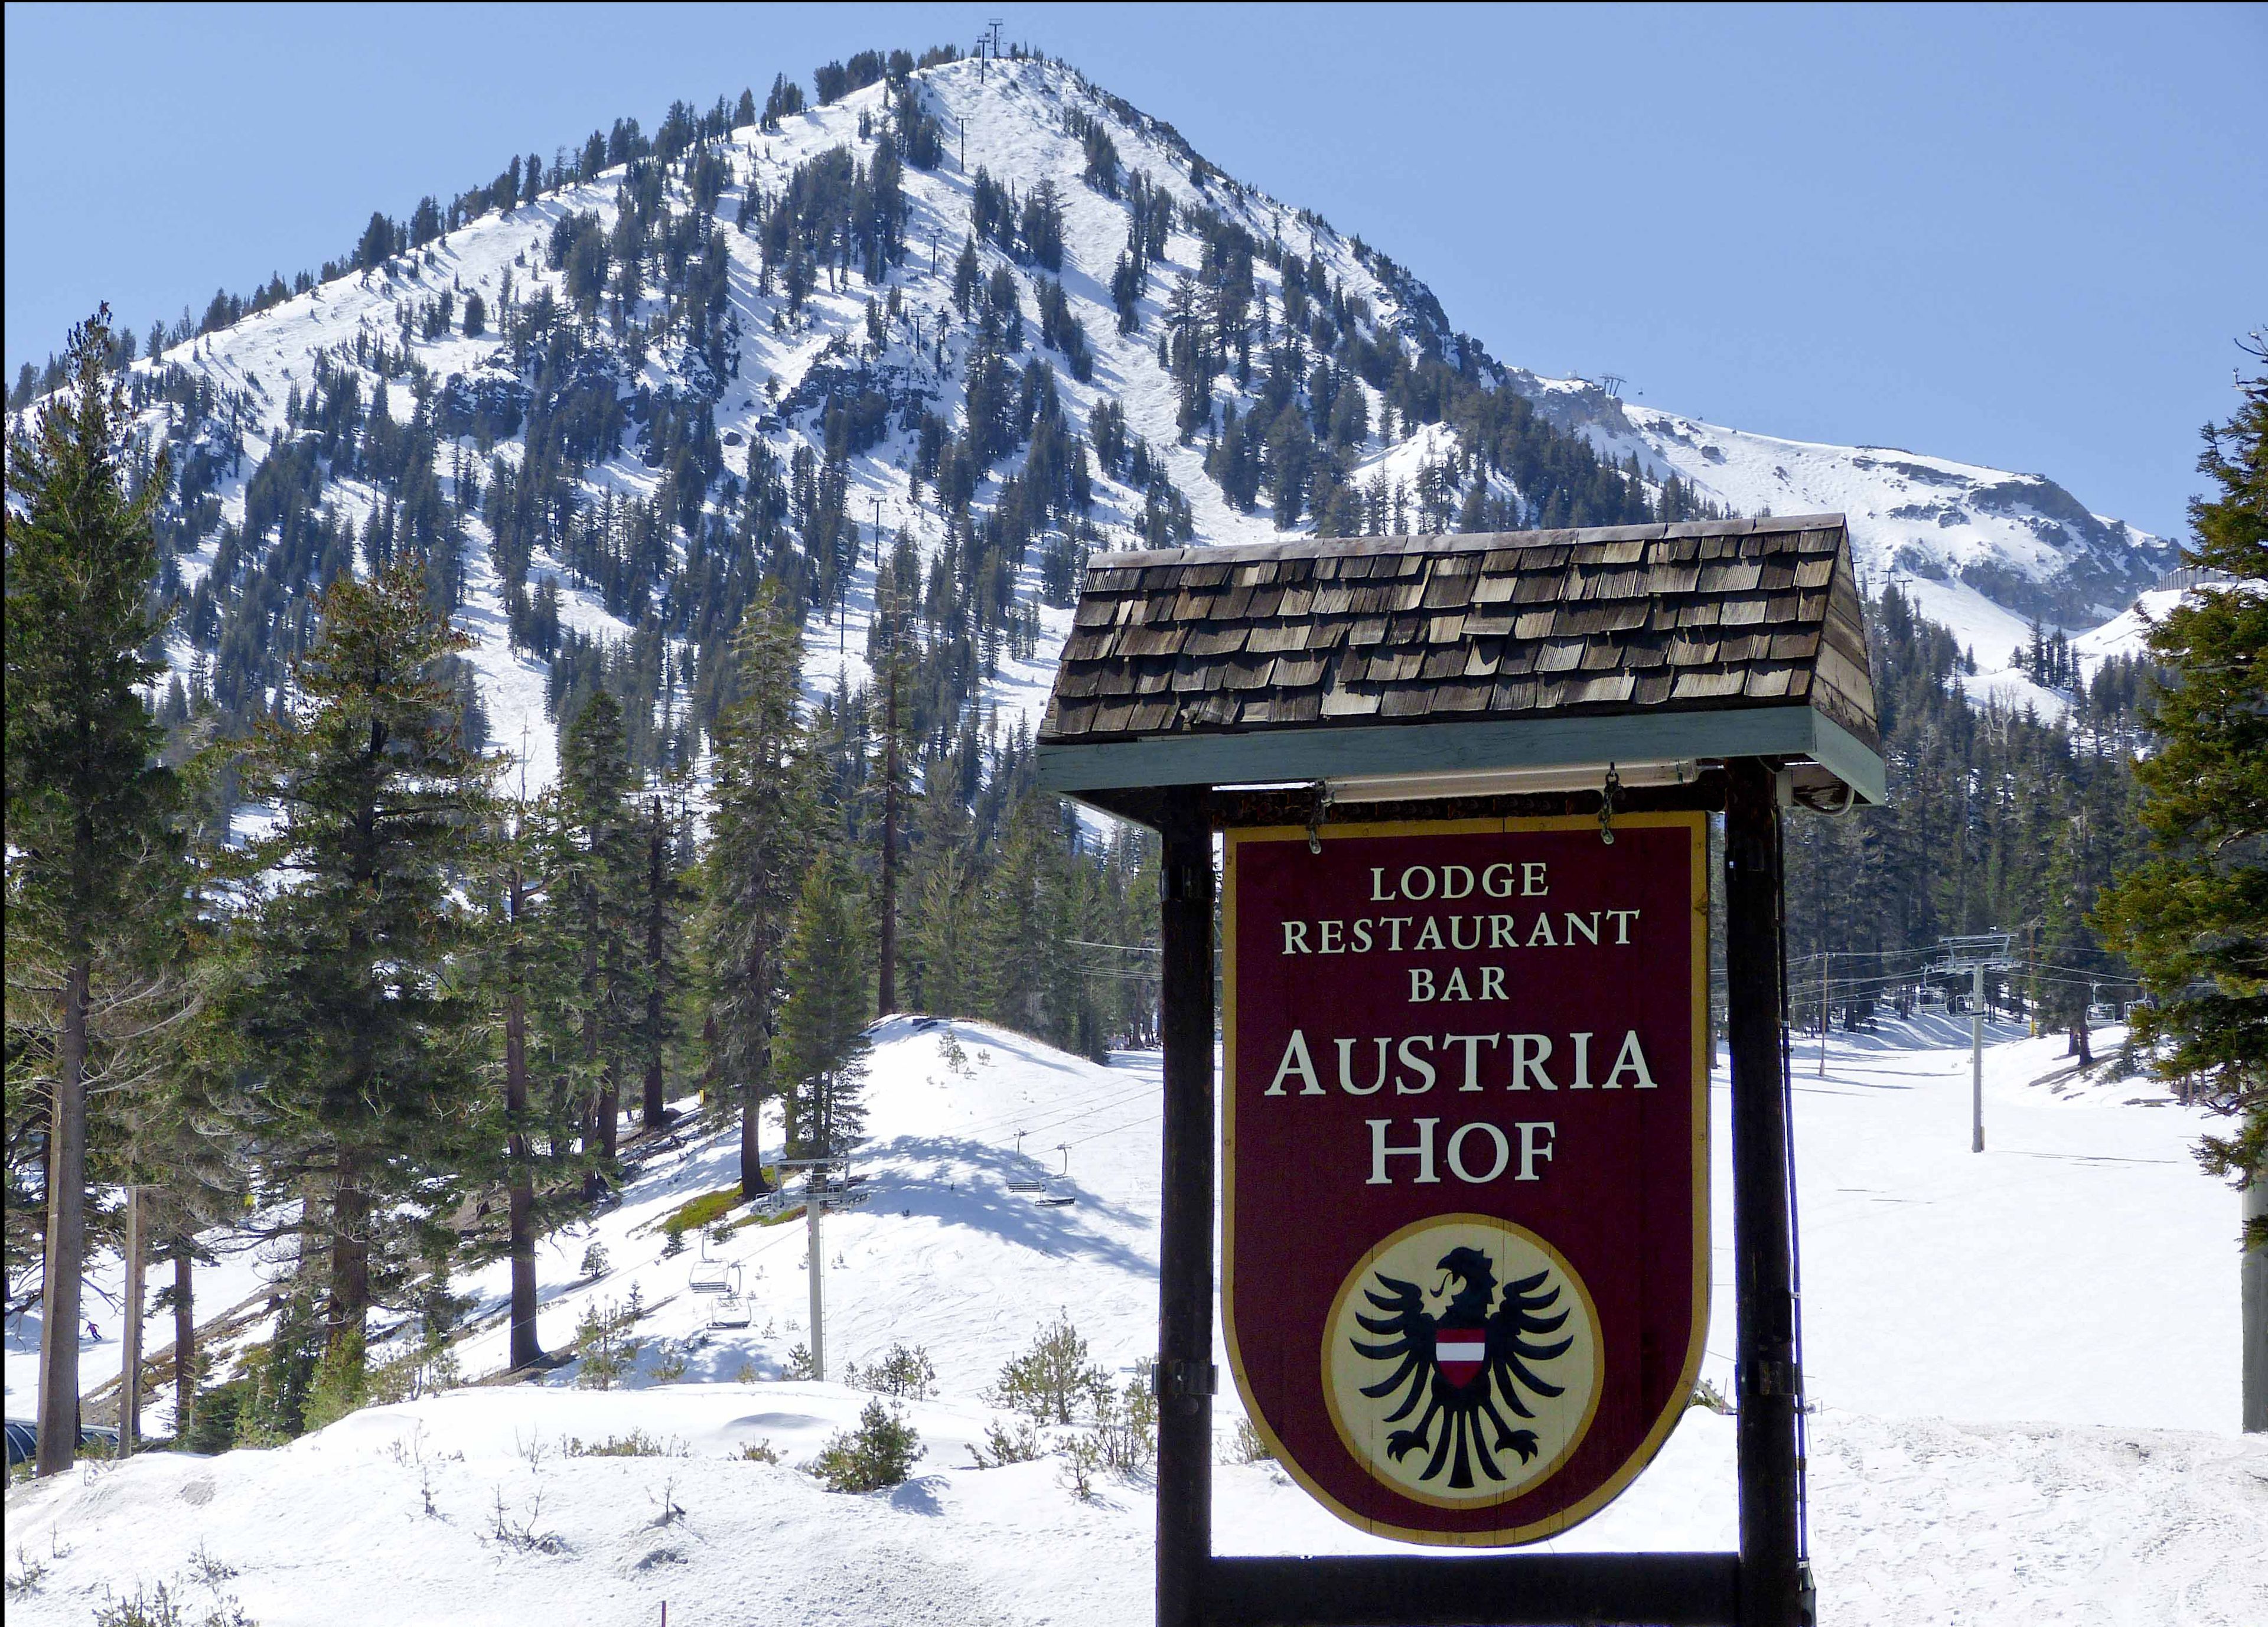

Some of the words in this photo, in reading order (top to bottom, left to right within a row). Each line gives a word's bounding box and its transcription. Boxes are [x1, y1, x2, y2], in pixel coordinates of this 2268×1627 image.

[1370, 862, 1549, 901] LODGE
[1281, 909, 1640, 954] RESTAURANT
[1408, 967, 1509, 1002] BAR
[1264, 1029, 1657, 1096] AUSTRIA
[1365, 1117, 1556, 1185] HOF
